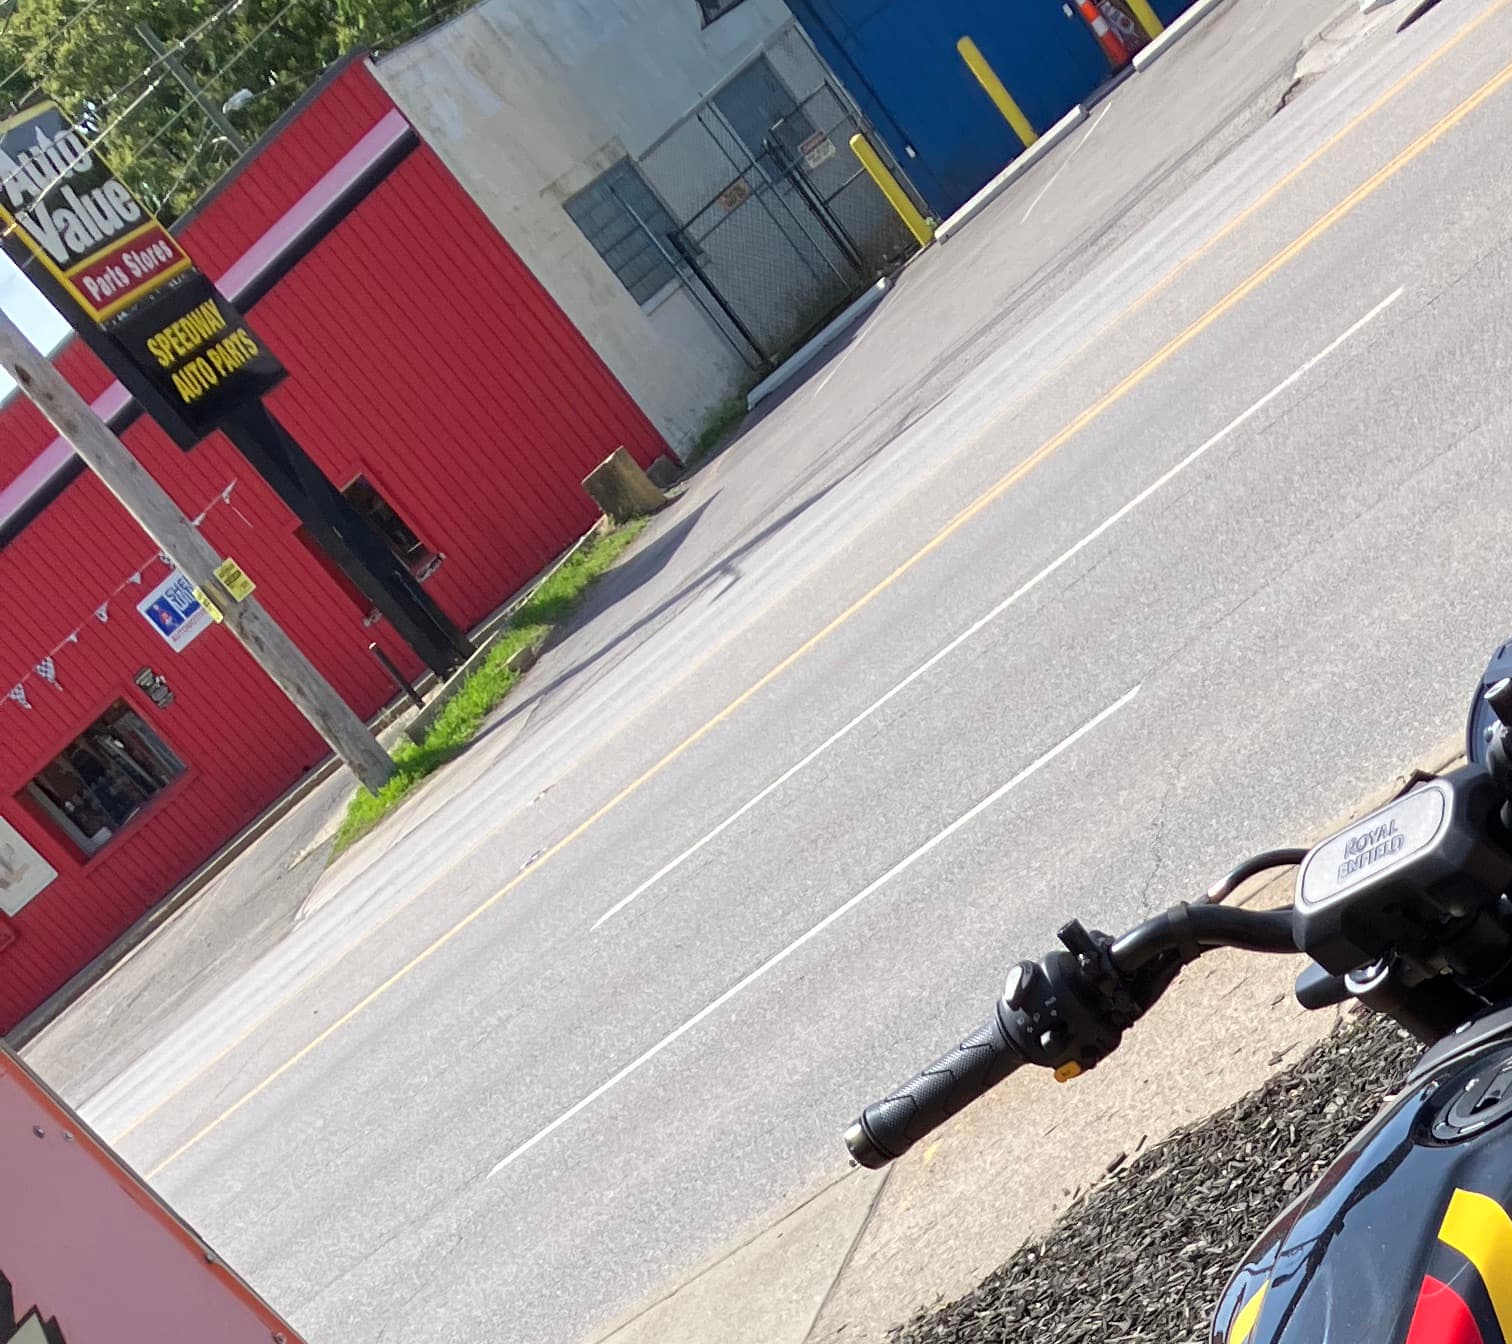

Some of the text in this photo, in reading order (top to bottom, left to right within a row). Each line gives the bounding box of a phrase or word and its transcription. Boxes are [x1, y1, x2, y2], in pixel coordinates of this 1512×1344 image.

[0, 126, 92, 207] Auto
[15, 180, 141, 264] Value
[82, 239, 173, 302] Parts Stores
[147, 298, 226, 367] SPEEDWAY
[171, 328, 258, 403] AUTO PARTS
[1336, 833, 1405, 885] ENFIELD
[1343, 818, 1399, 860] ROYAL
